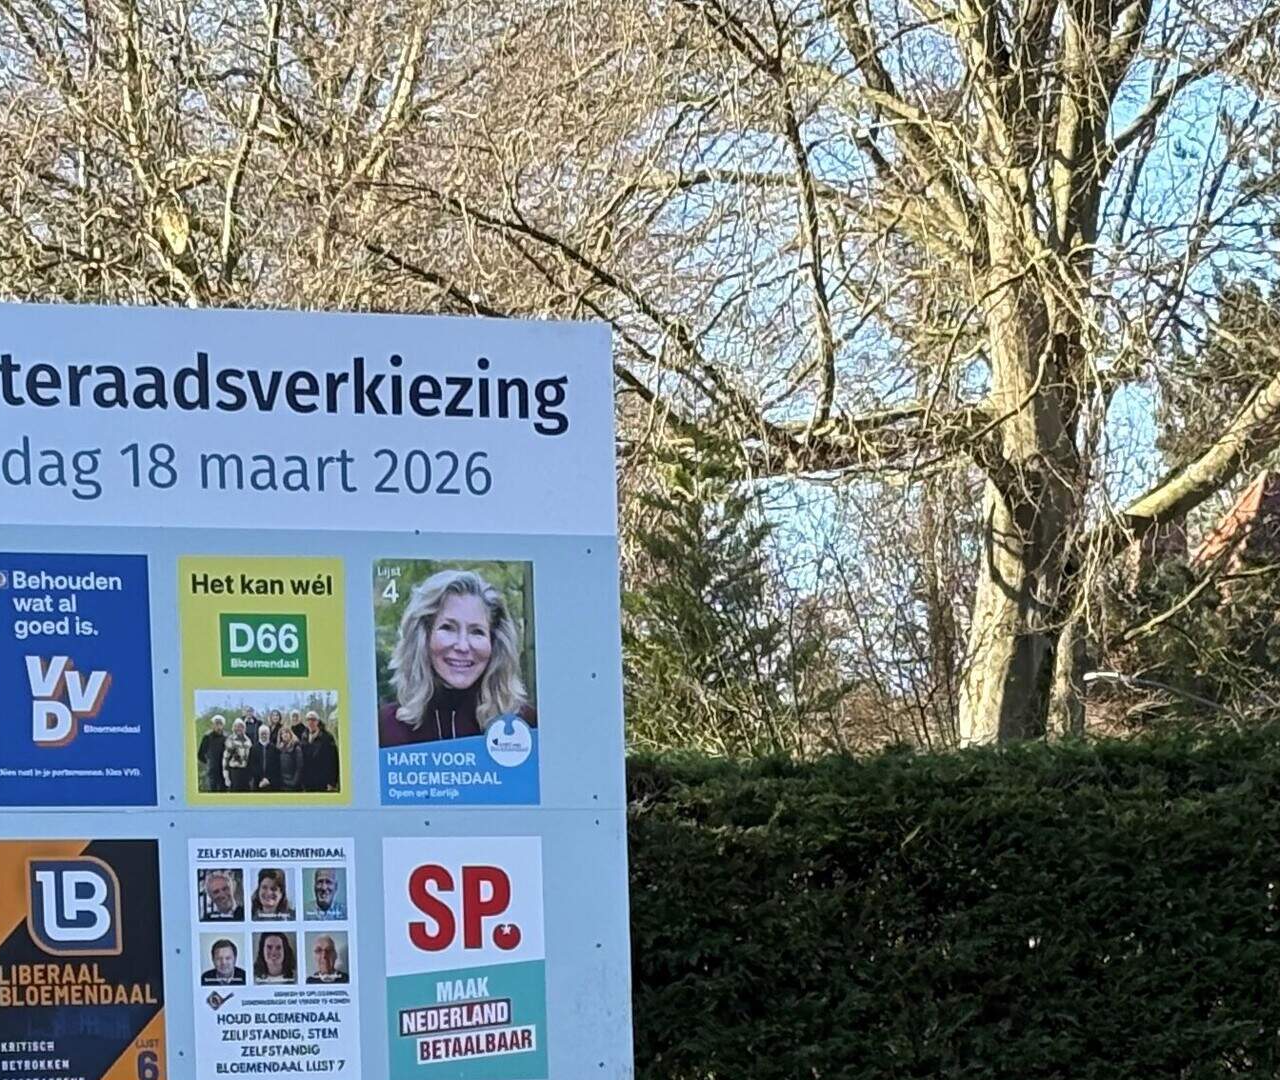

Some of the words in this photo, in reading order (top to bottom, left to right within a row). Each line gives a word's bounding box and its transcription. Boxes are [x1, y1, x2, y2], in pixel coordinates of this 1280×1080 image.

[119, 442, 179, 490] 18
[199, 447, 358, 493] maart
[373, 447, 493, 496] 2026
[12, 570, 122, 591] Behouden
[191, 573, 235, 595] Het
[240, 574, 285, 596] kan
[290, 573, 333, 596] wél
[382, 579, 400, 603] 4
[13, 594, 54, 613] wat
[58, 594, 77, 613] al
[14, 616, 70, 640] goed
[75, 616, 99, 636] is.
[228, 622, 300, 654] D66
[230, 657, 300, 669] Bloemendaal
[24, 655, 110, 745] VVD
[386, 752, 428, 766] HART
[431, 752, 476, 766] VOOR
[387, 771, 502, 785] BLOEMENDAAL
[196, 847, 268, 859] ZELFSTANDIG
[270, 847, 347, 859] BLOEMENDAAL
[436, 976, 490, 1002] MAAK
[216, 1013, 252, 1026] HOUD
[254, 1011, 341, 1025] BLOEMENDAAL
[401, 1000, 509, 1035] NEDERLAND
[222, 1028, 305, 1042] ZELFSTANDIG,
[307, 1027, 339, 1039] STEM
[0, 1040, 55, 1053] KRITISCH
[240, 1044, 321, 1058] ZELFSTANDIG
[419, 1028, 533, 1062] BETAALBAAR
[1, 1058, 70, 1072] BETROKKEN
[216, 1060, 304, 1074] BLOEMENDAAL
[336, 1059, 347, 1072] 7
